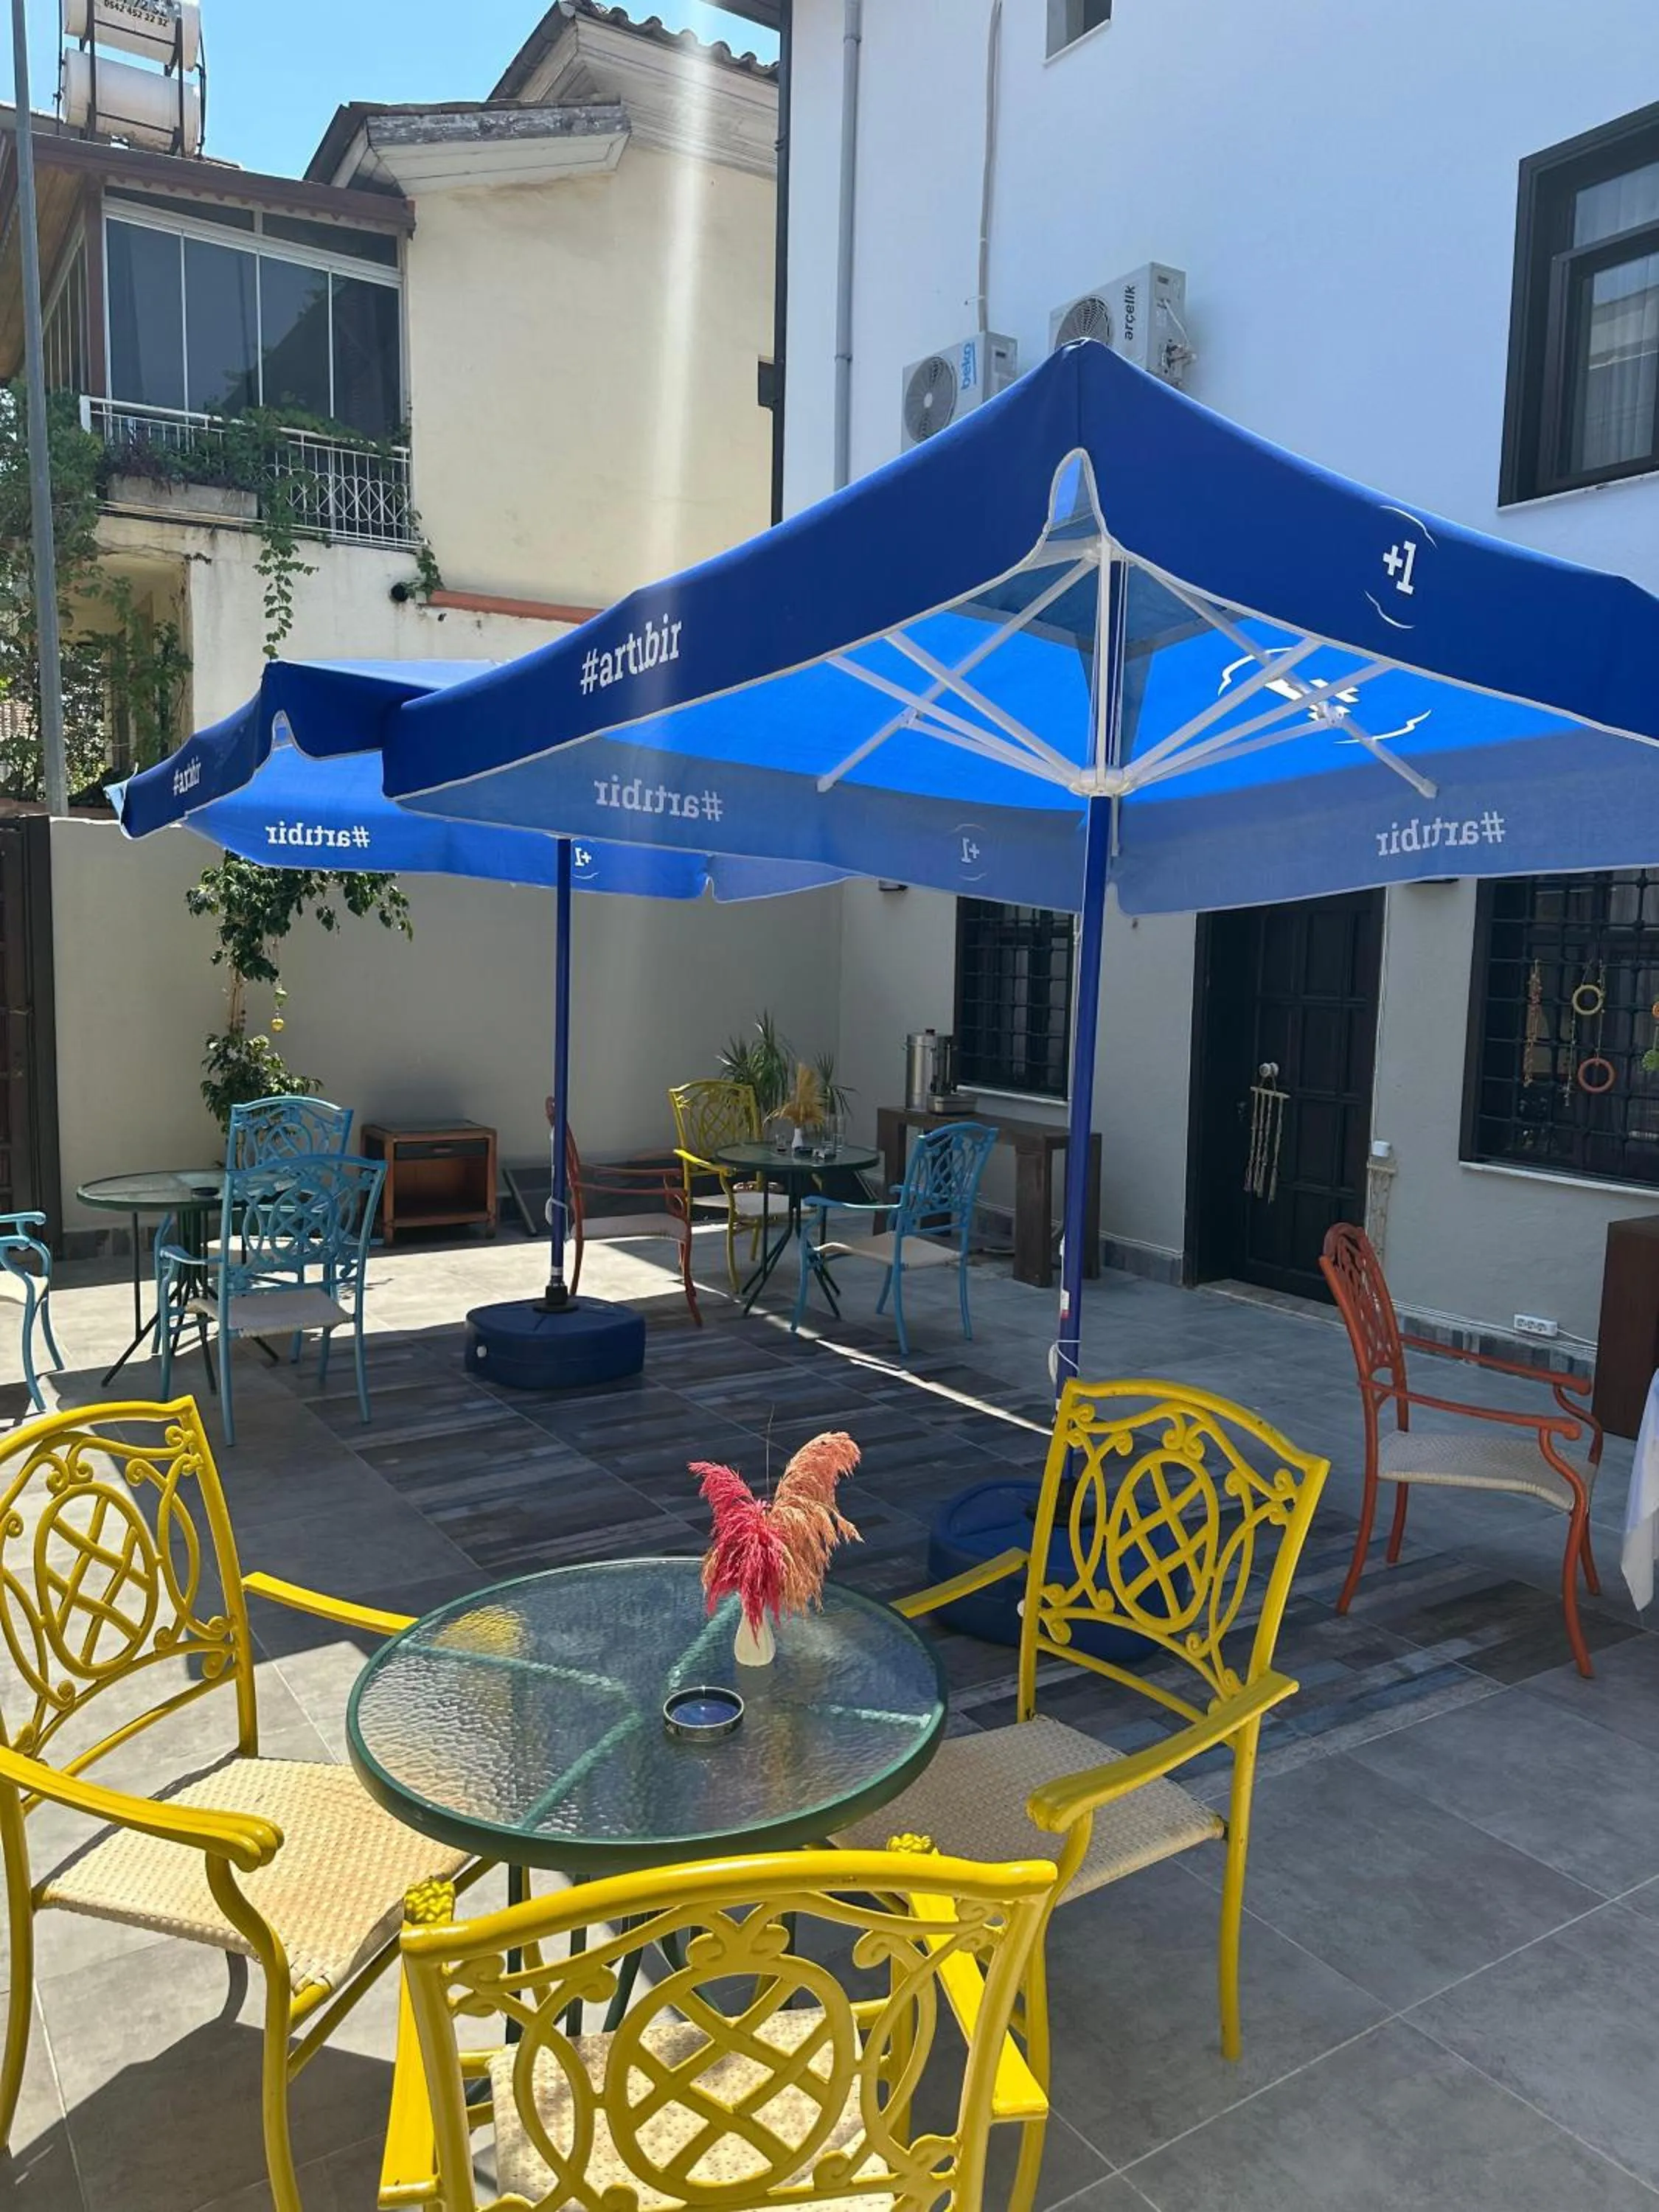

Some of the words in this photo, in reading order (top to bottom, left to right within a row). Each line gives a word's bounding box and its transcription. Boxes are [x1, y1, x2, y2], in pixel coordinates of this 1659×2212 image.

[961, 342, 972, 390] beko
[1382, 540, 1416, 595] +1
[580, 613, 682, 695] #artıbir
